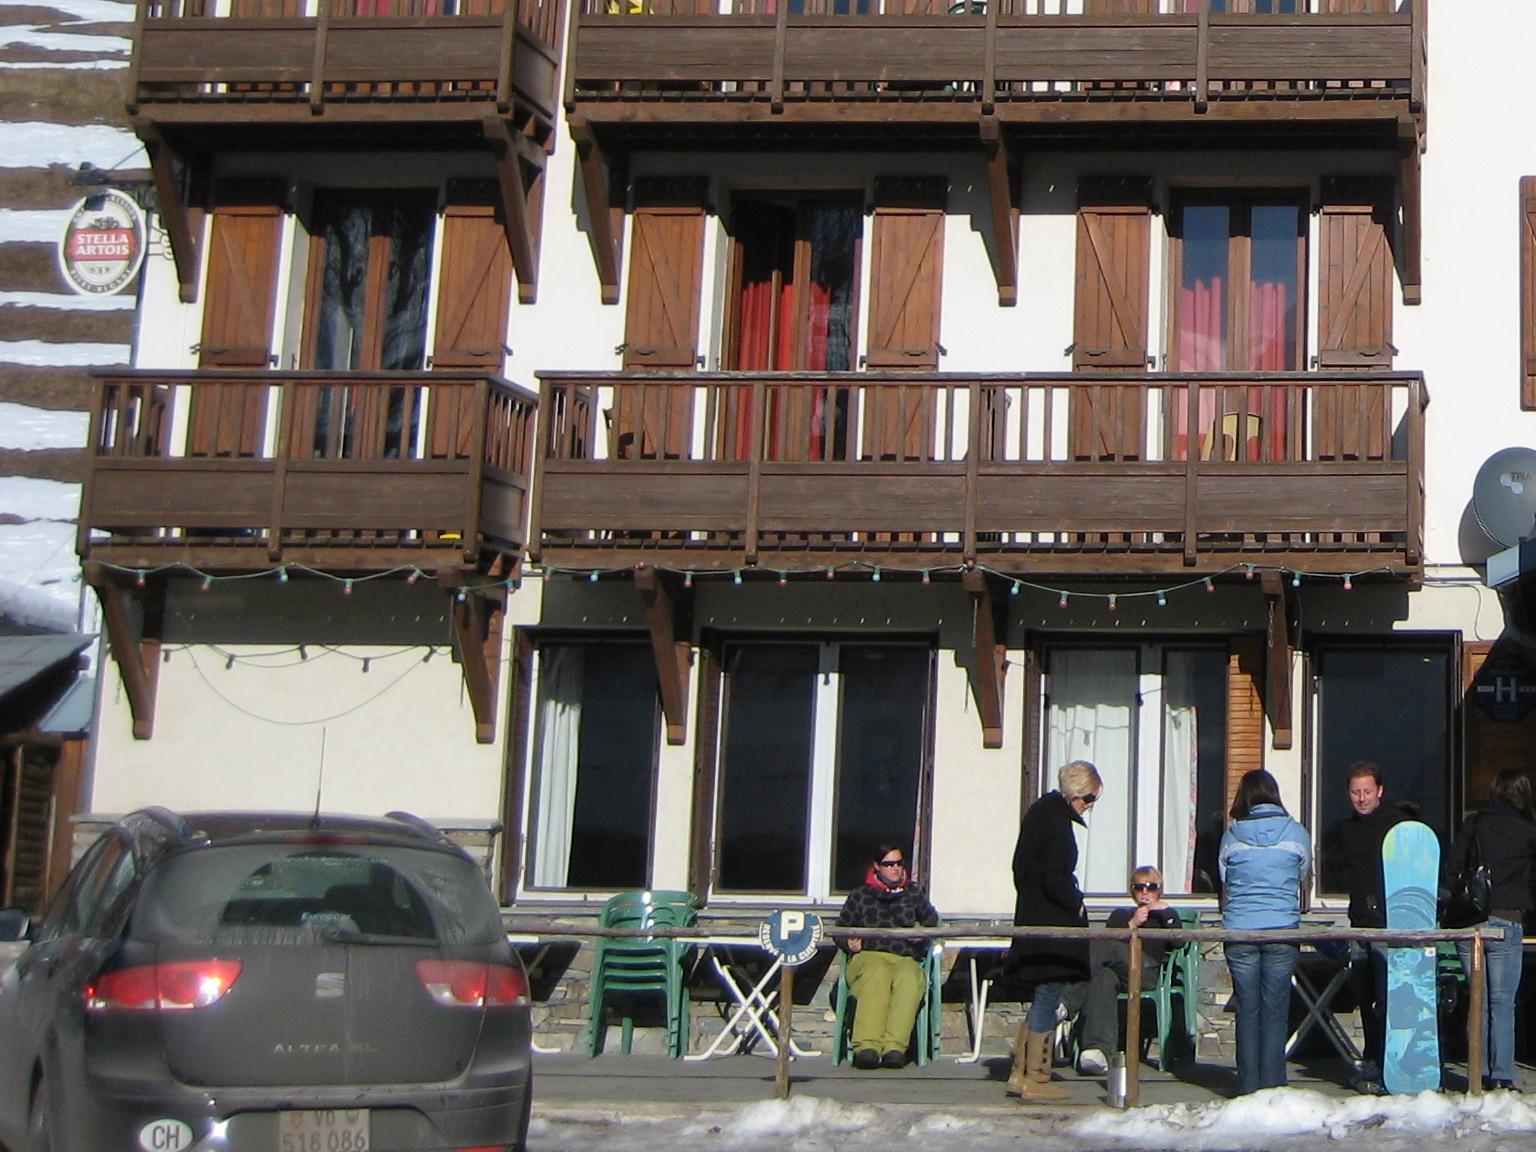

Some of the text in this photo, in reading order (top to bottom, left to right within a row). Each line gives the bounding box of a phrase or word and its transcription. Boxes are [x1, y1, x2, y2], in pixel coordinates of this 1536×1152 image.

[75, 245, 130, 256] ARTOIS
[77, 233, 129, 245] STELLA
[1496, 677, 1517, 702] H
[780, 911, 805, 941] P
[152, 1124, 180, 1150] CH
